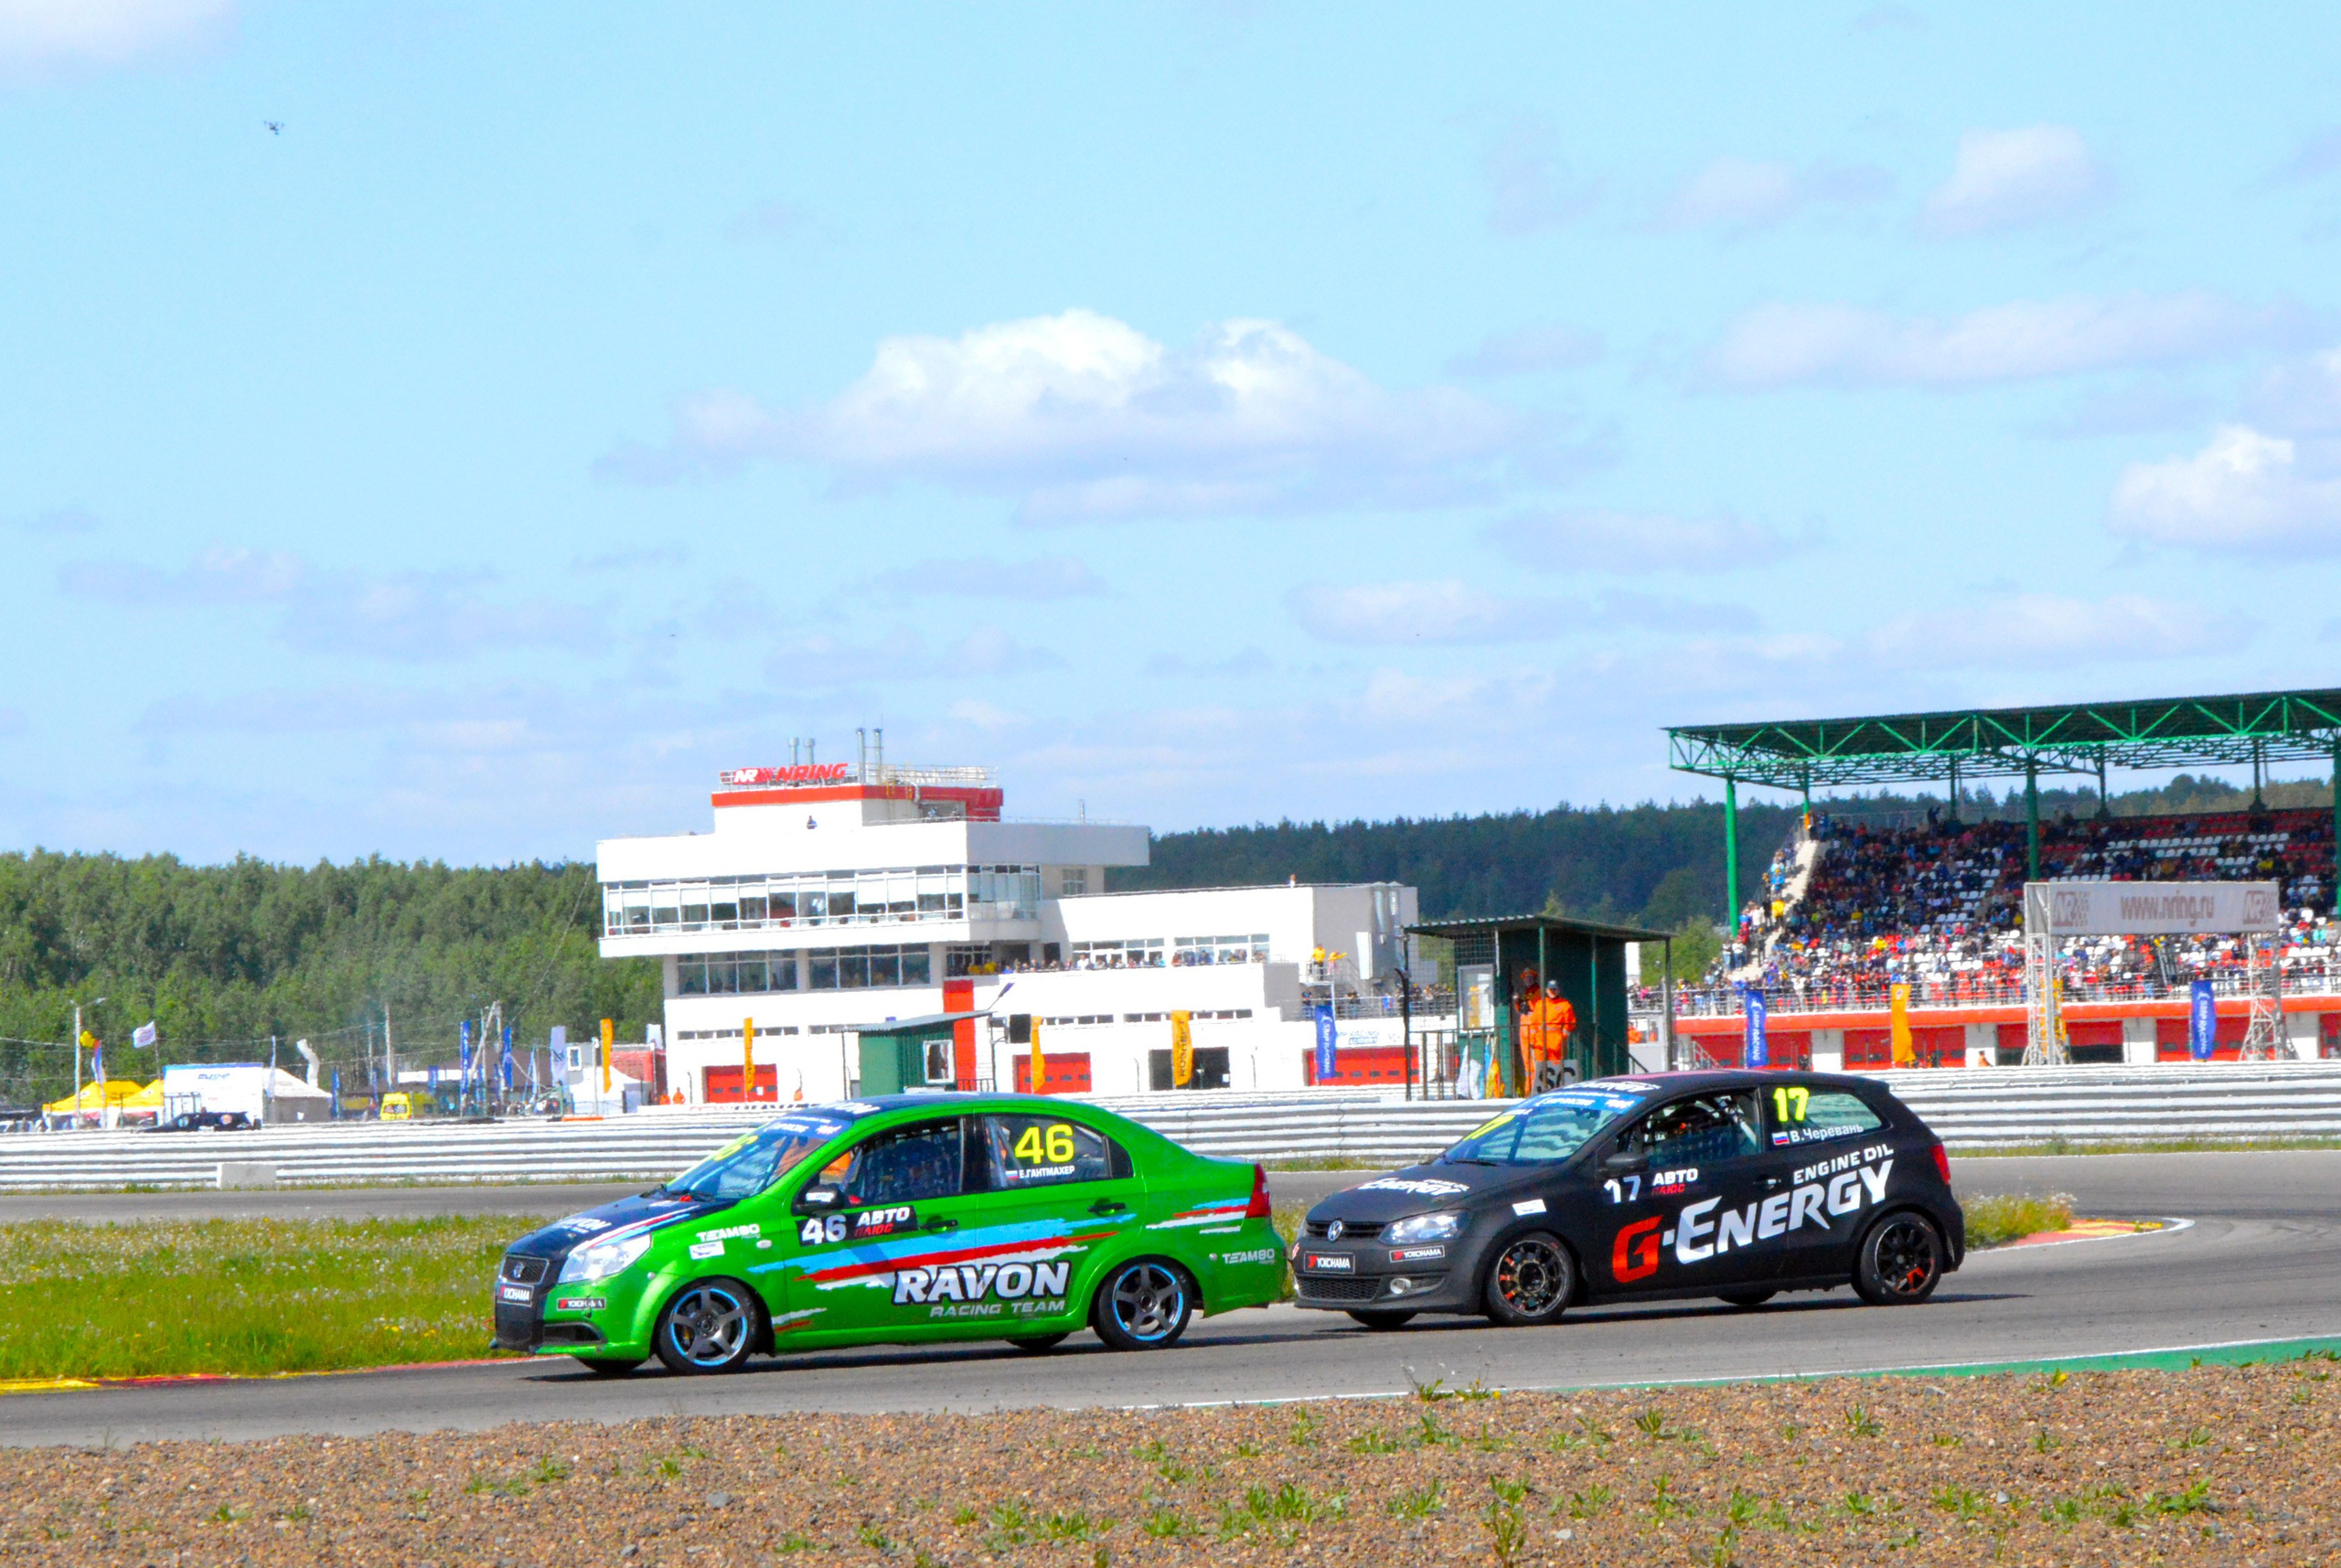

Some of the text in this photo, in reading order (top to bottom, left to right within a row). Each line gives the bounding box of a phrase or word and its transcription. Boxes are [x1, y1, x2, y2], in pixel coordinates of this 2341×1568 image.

[775, 763, 849, 782] NRING
[2120, 890, 2215, 926] www.nring.ru
[1774, 1087, 1810, 1122] 17
[1790, 1124, 1865, 1143] В.Черевань
[1014, 1124, 1074, 1165] 46
[1793, 1143, 1895, 1186] ENGINE OIL
[1652, 1168, 1699, 1187] АВТО
[1603, 1175, 1641, 1203] 17
[856, 1207, 911, 1227] АВТО
[801, 1214, 847, 1244] 46
[1222, 1248, 1275, 1264] TEAM80
[1317, 1256, 1351, 1269] YOKOHAMA
[1403, 1248, 1442, 1260] YOKOHAMA
[893, 1261, 1071, 1304] RAVON
[929, 1300, 1065, 1317] RACING TEAM
